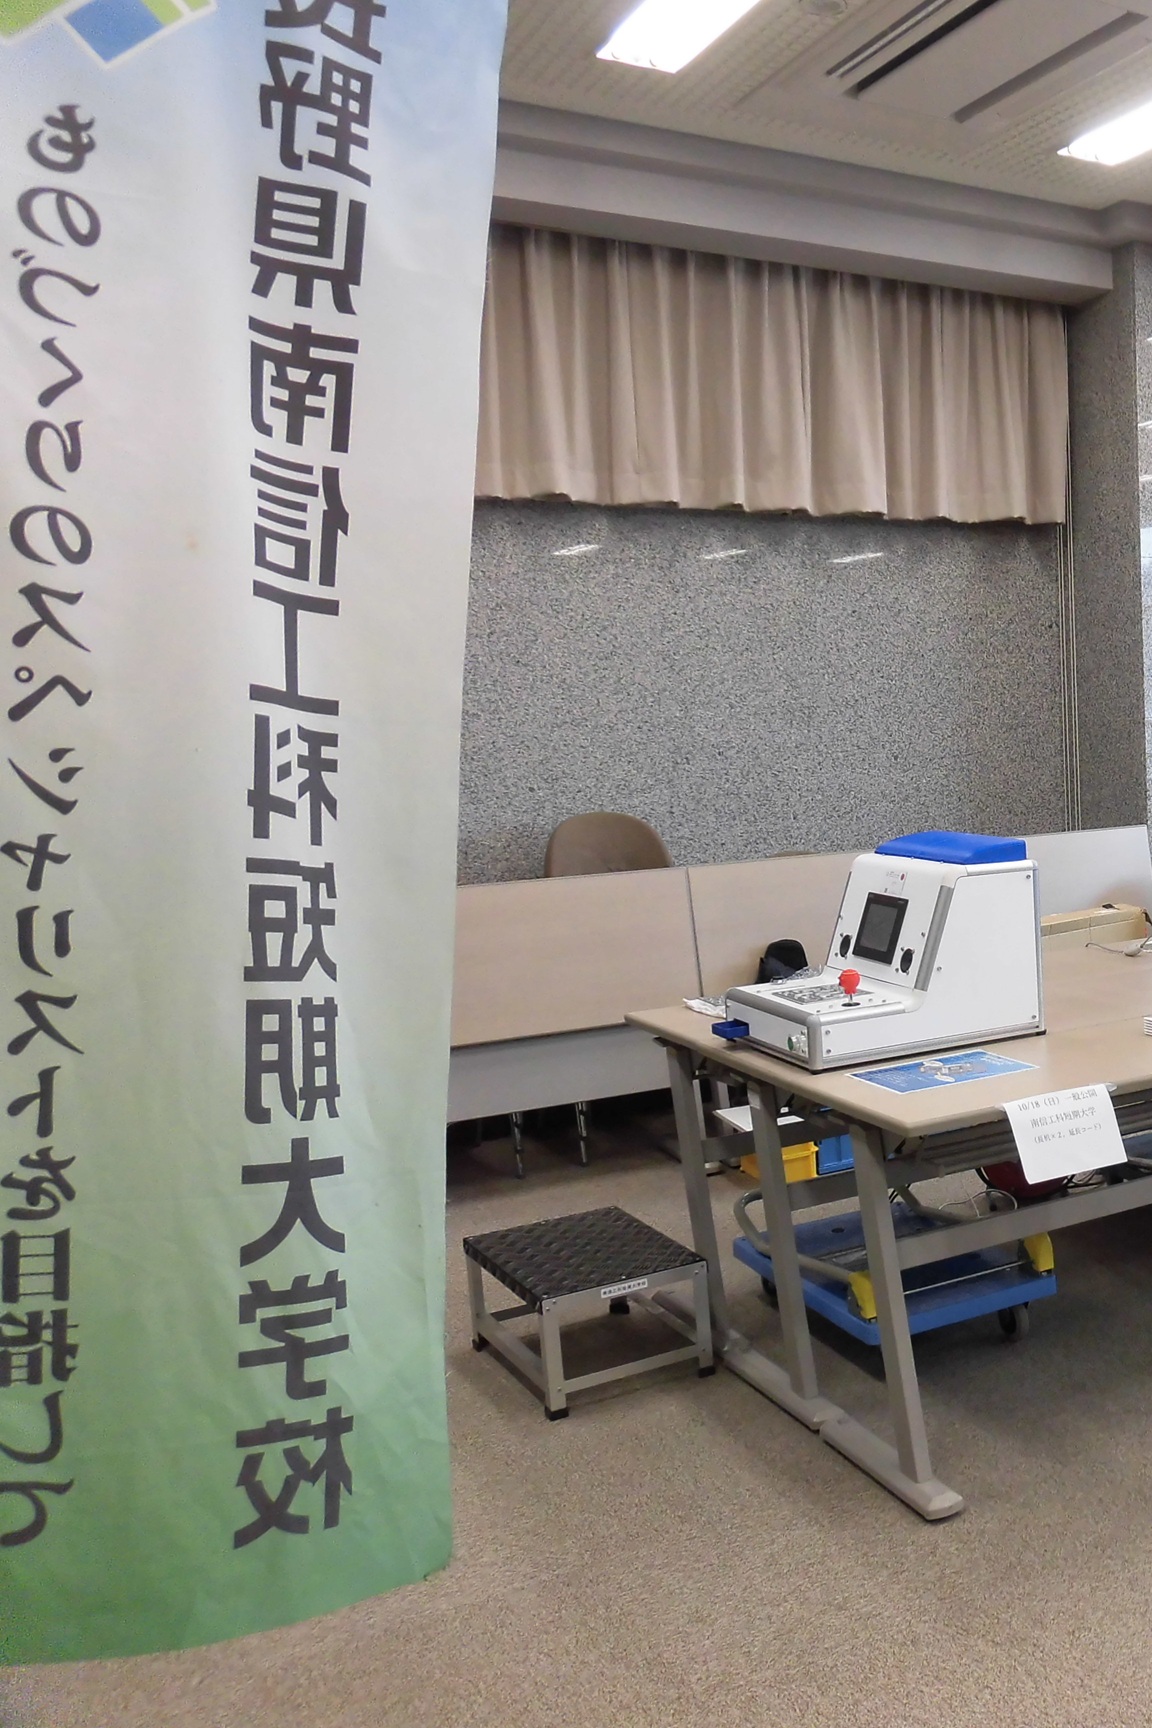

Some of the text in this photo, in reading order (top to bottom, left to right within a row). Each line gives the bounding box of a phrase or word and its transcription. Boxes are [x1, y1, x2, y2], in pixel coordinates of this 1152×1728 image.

[1030, 1106, 1097, 1128] 南信工科短期大学
